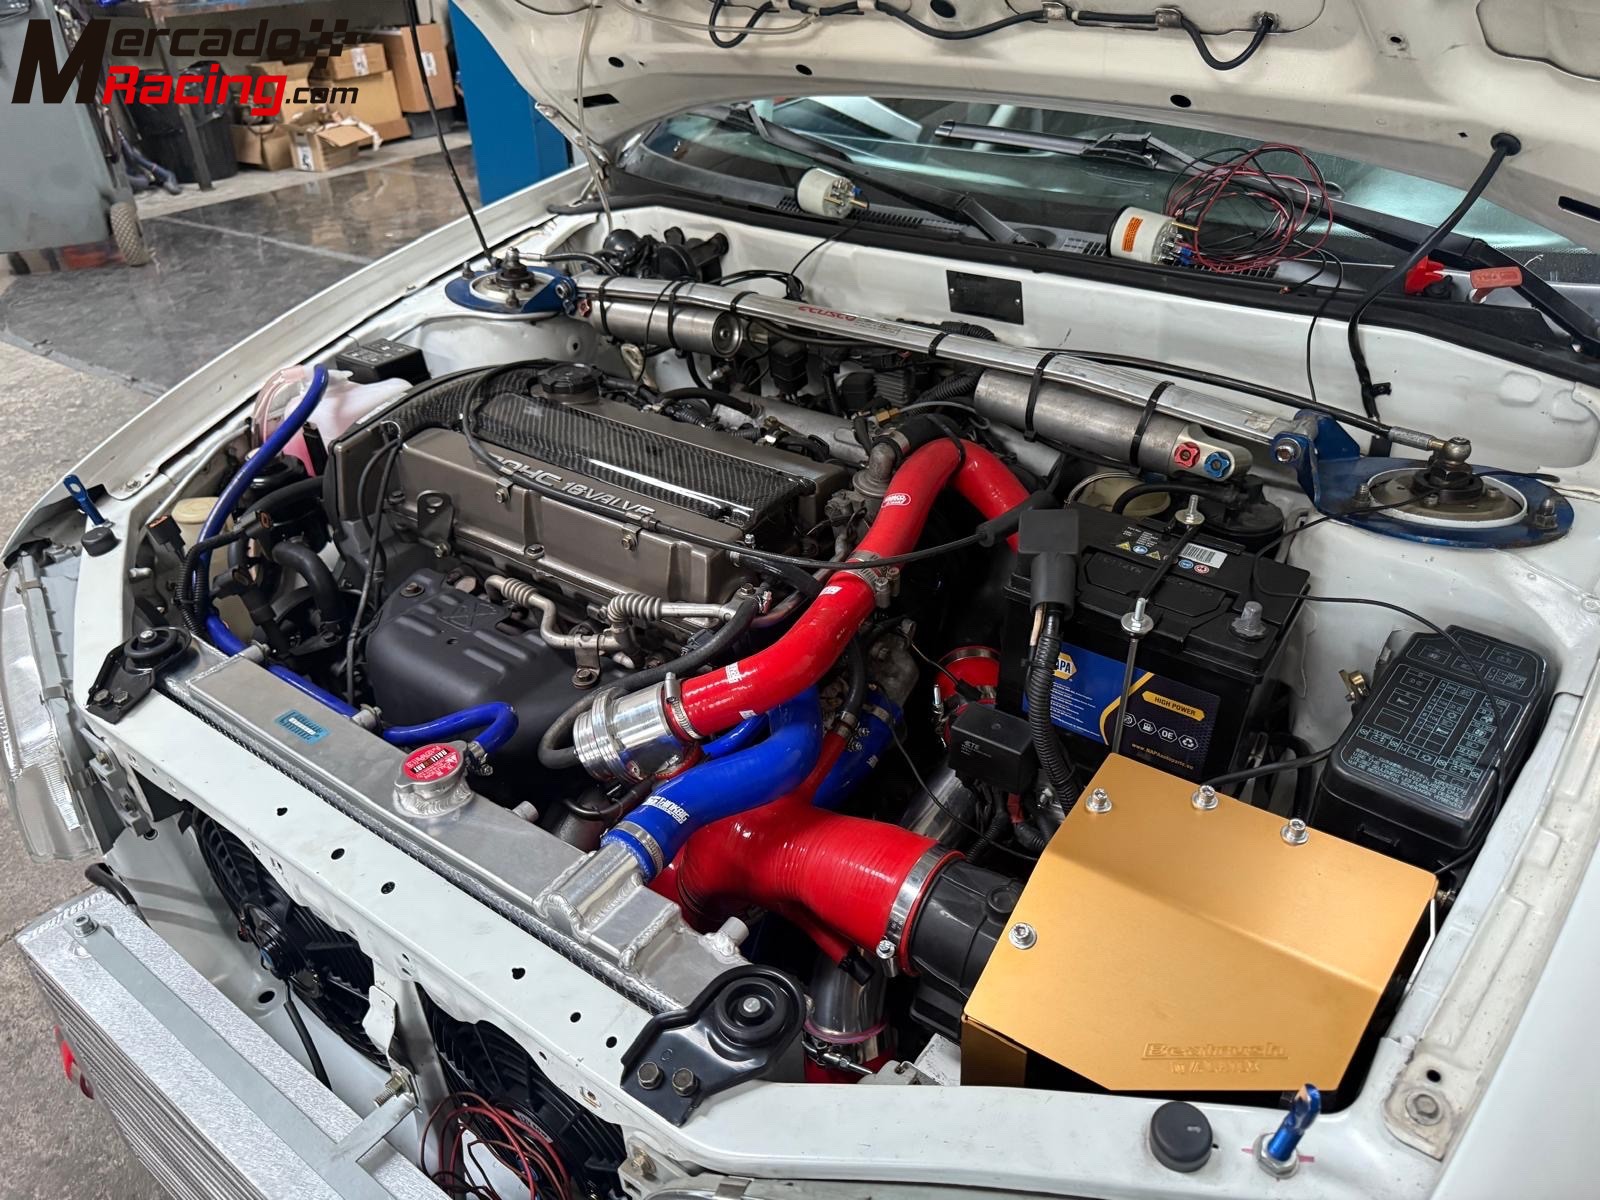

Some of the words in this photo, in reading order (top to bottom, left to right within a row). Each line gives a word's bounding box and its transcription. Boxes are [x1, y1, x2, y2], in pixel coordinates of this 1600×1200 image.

[1154, 696, 1171, 707] HIGH
[1171, 702, 1197, 716] POWER
[1161, 728, 1173, 740] OE
